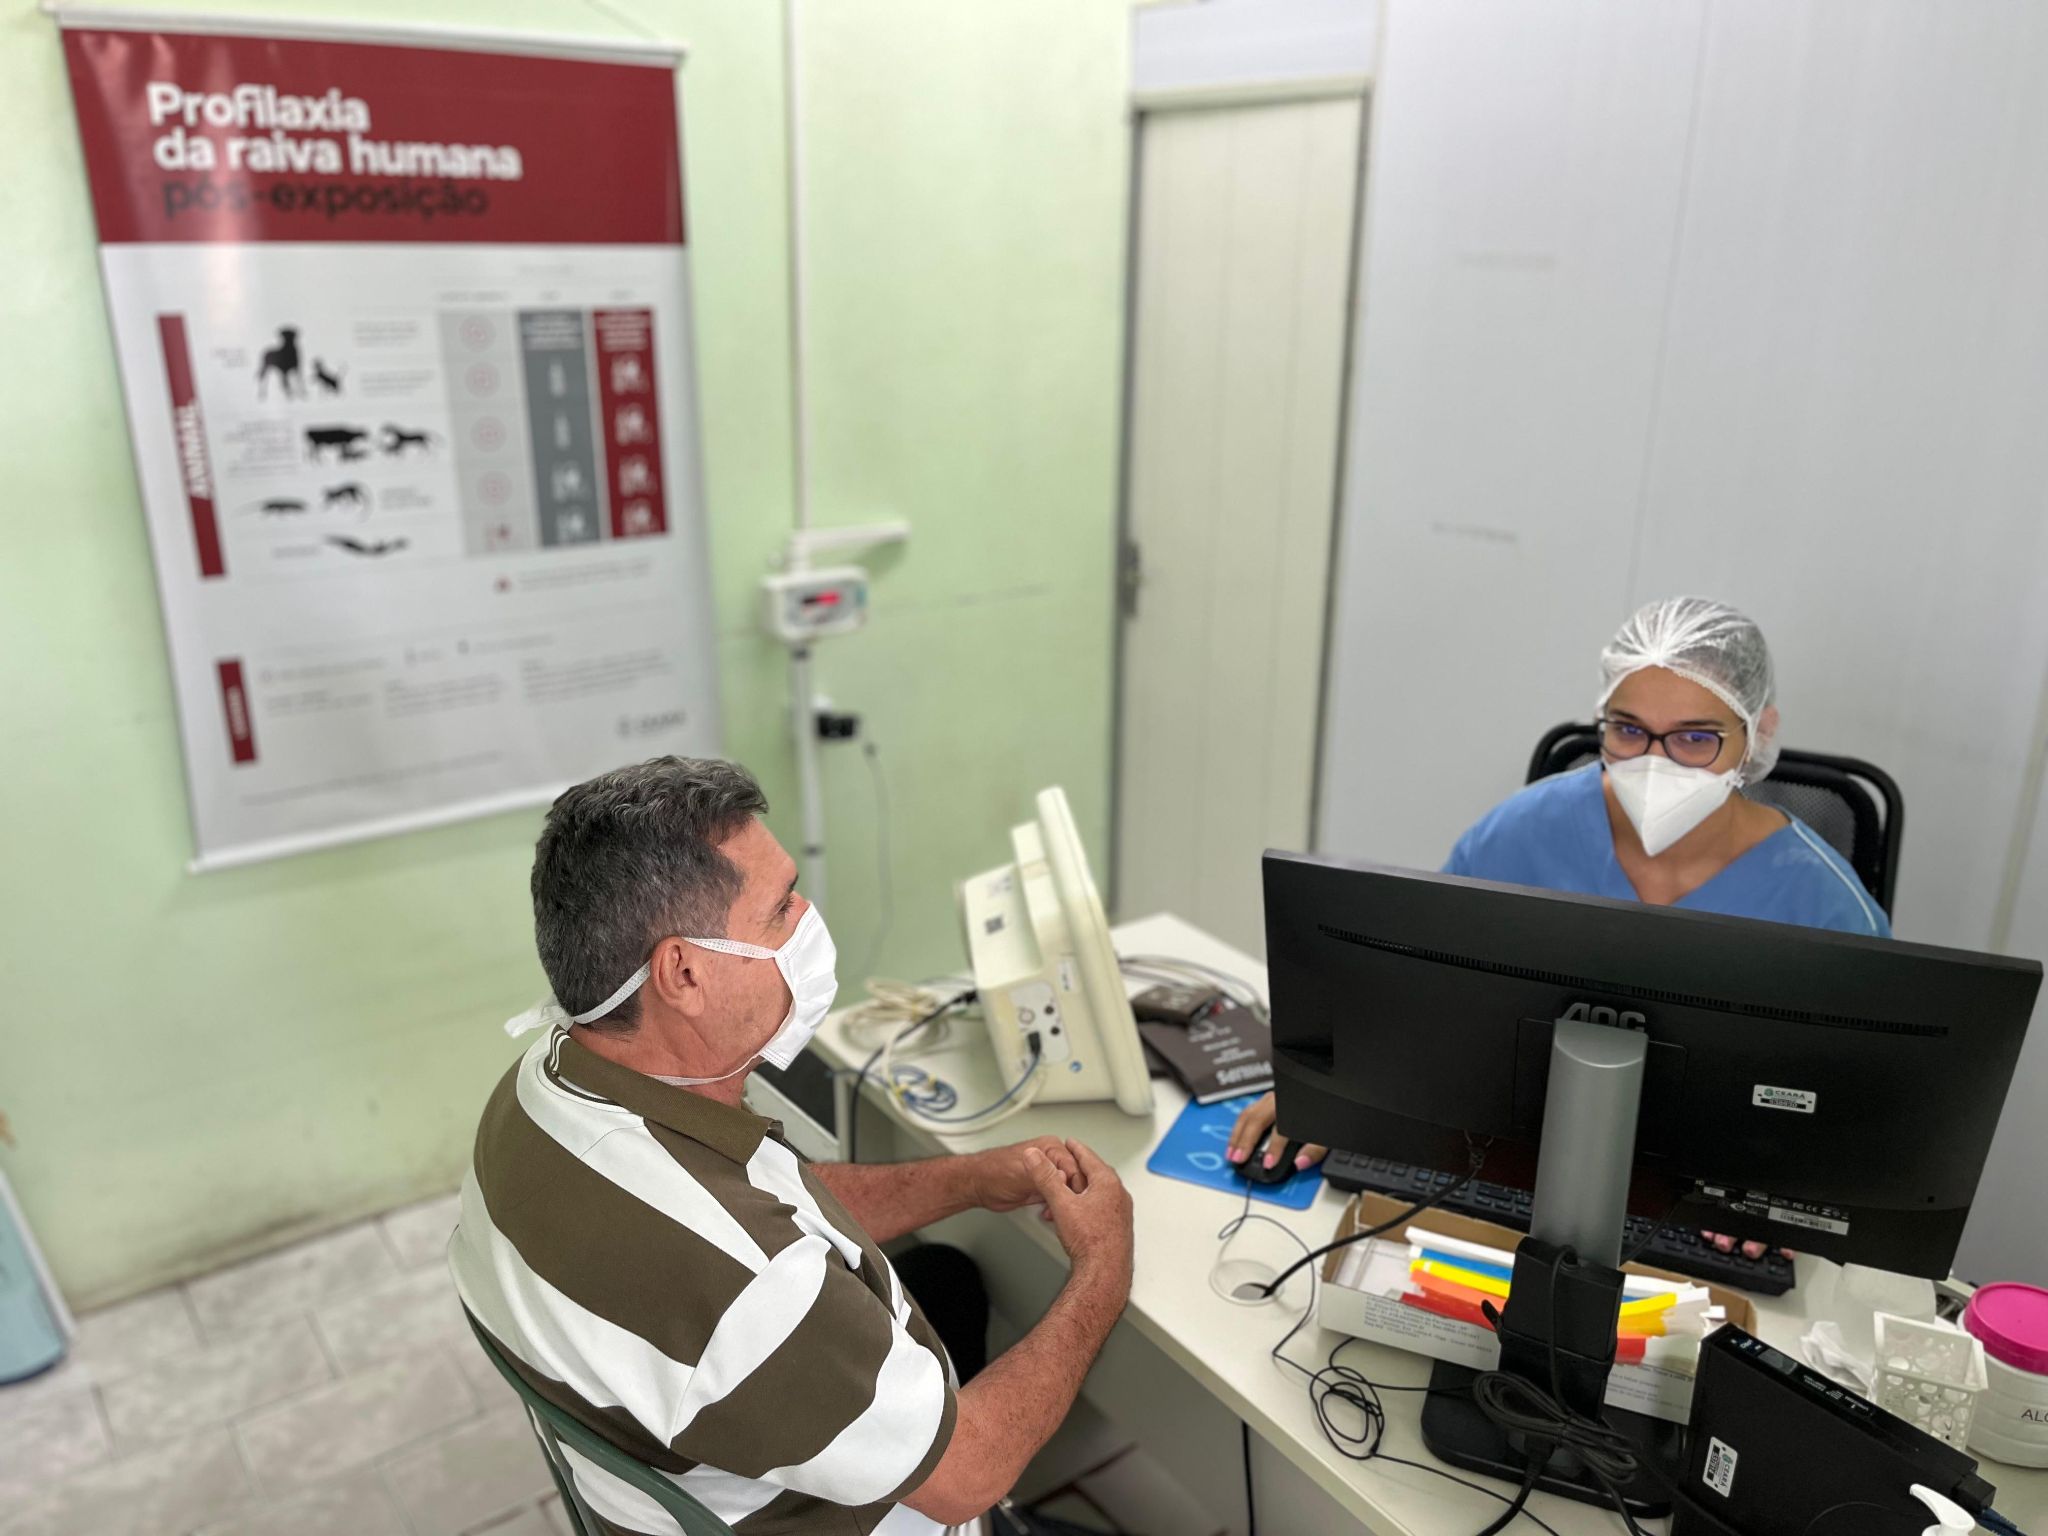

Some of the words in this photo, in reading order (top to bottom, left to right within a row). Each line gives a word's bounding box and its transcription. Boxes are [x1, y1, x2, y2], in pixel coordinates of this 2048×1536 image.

[147, 82, 371, 132] Profilaxia
[154, 129, 214, 169] da
[227, 130, 342, 174] raiva
[349, 133, 522, 179] humana
[164, 177, 486, 217] pós-exposição
[1560, 1002, 1646, 1032] AOC
